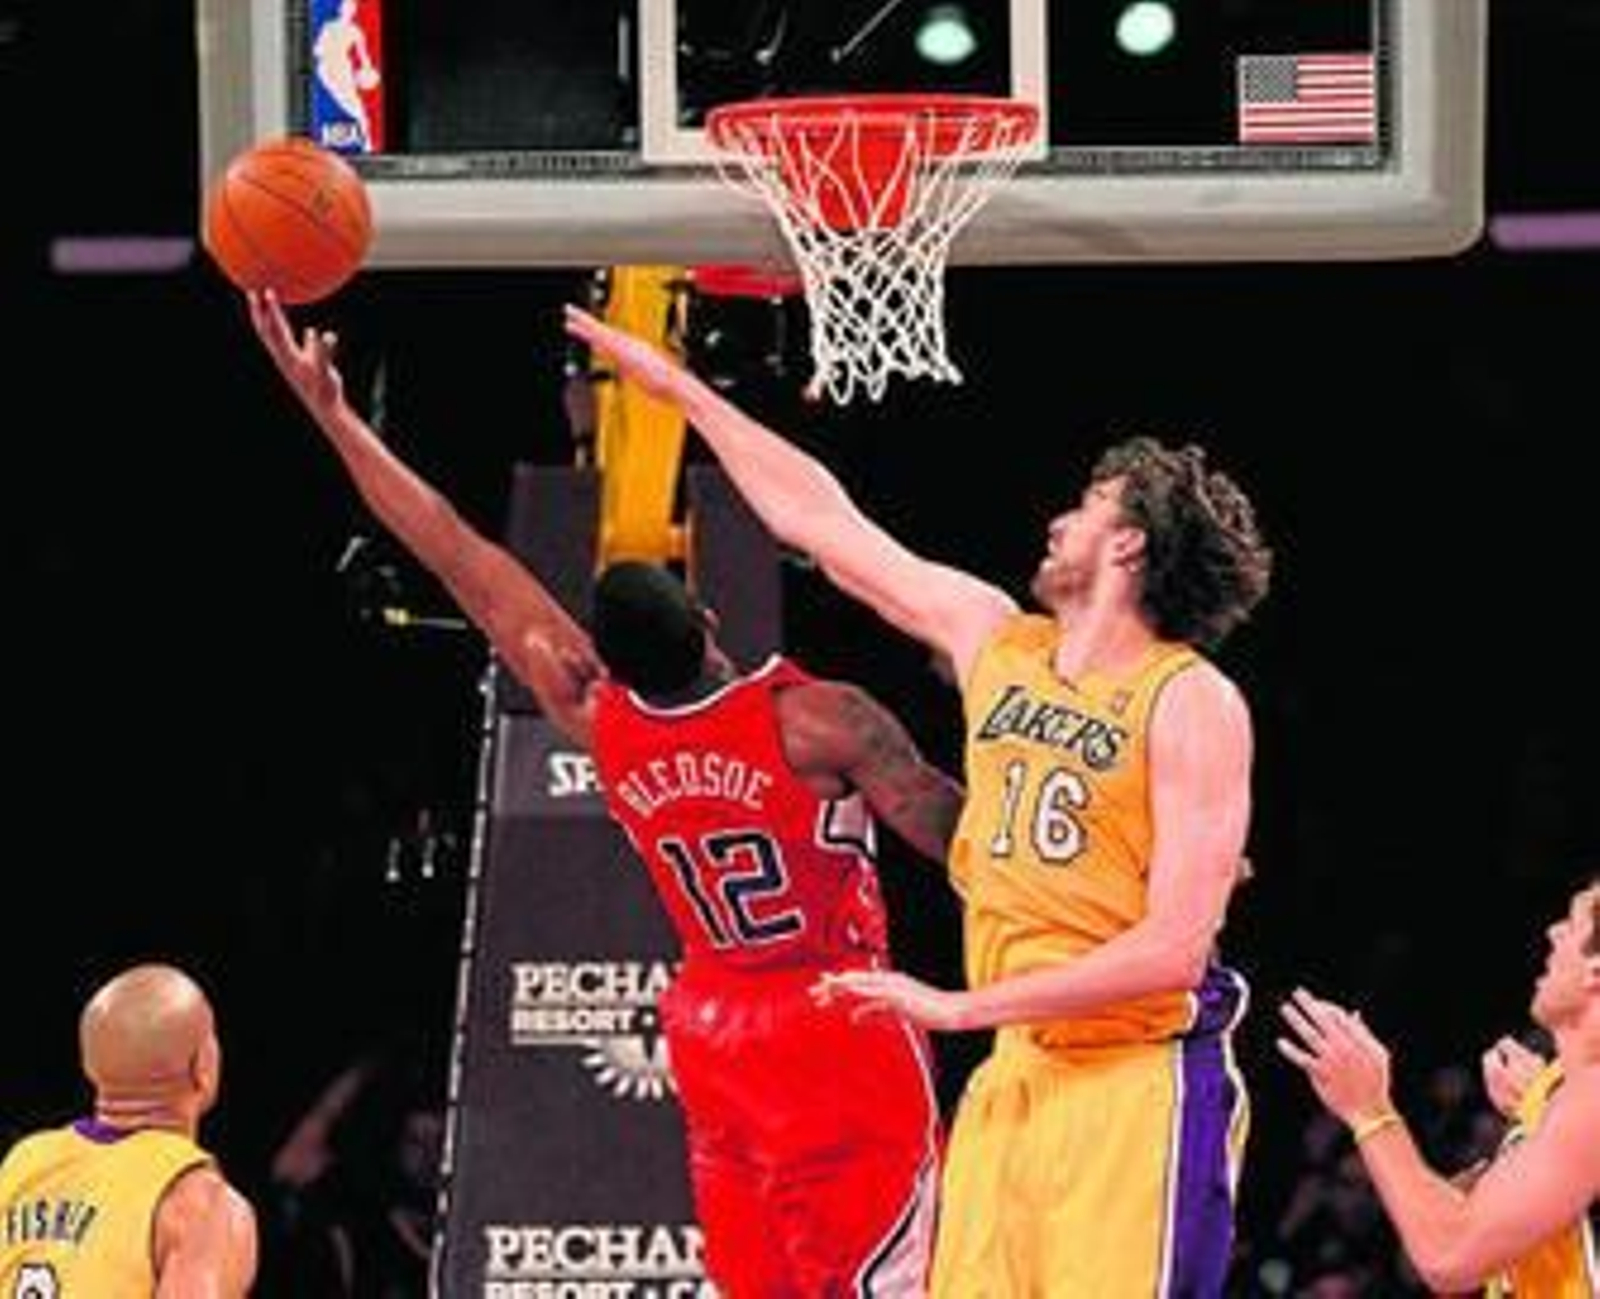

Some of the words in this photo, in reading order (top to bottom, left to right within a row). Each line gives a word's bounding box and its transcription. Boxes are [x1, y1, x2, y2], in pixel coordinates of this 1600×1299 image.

[320, 121, 363, 148] NBA
[977, 685, 1128, 770] LAKERS
[990, 758, 1092, 865] 16
[657, 829, 804, 948] 12
[511, 962, 686, 1004] PECHA
[512, 1008, 635, 1032] RESORT
